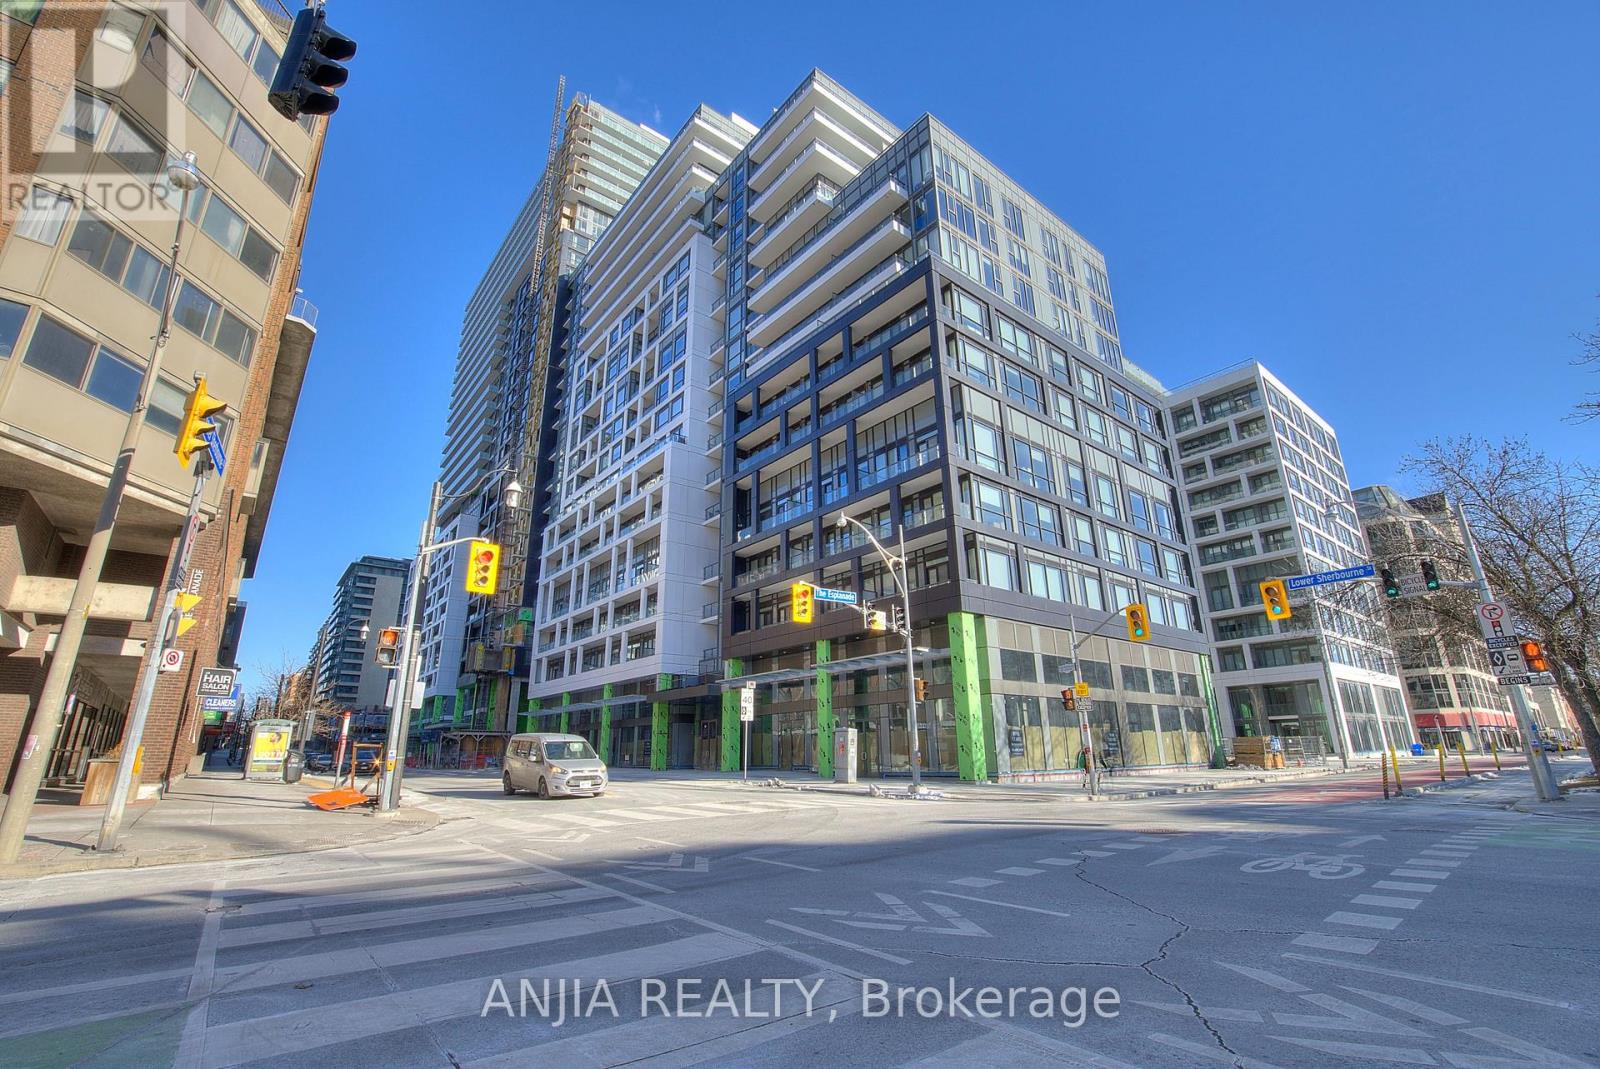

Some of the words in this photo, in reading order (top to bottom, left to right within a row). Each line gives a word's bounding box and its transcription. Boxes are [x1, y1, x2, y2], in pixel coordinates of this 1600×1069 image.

[1291, 578, 1314, 587] Lower
[1316, 568, 1364, 583] Sherbourne
[1404, 585, 1427, 594] SIGNAL
[815, 588, 826, 597] The
[829, 590, 856, 601] Esplanade
[204, 674, 231, 683] HAIR
[1500, 676, 1527, 684] BEGINS
[206, 698, 236, 706] CLEANERS
[743, 696, 753, 704] 40
